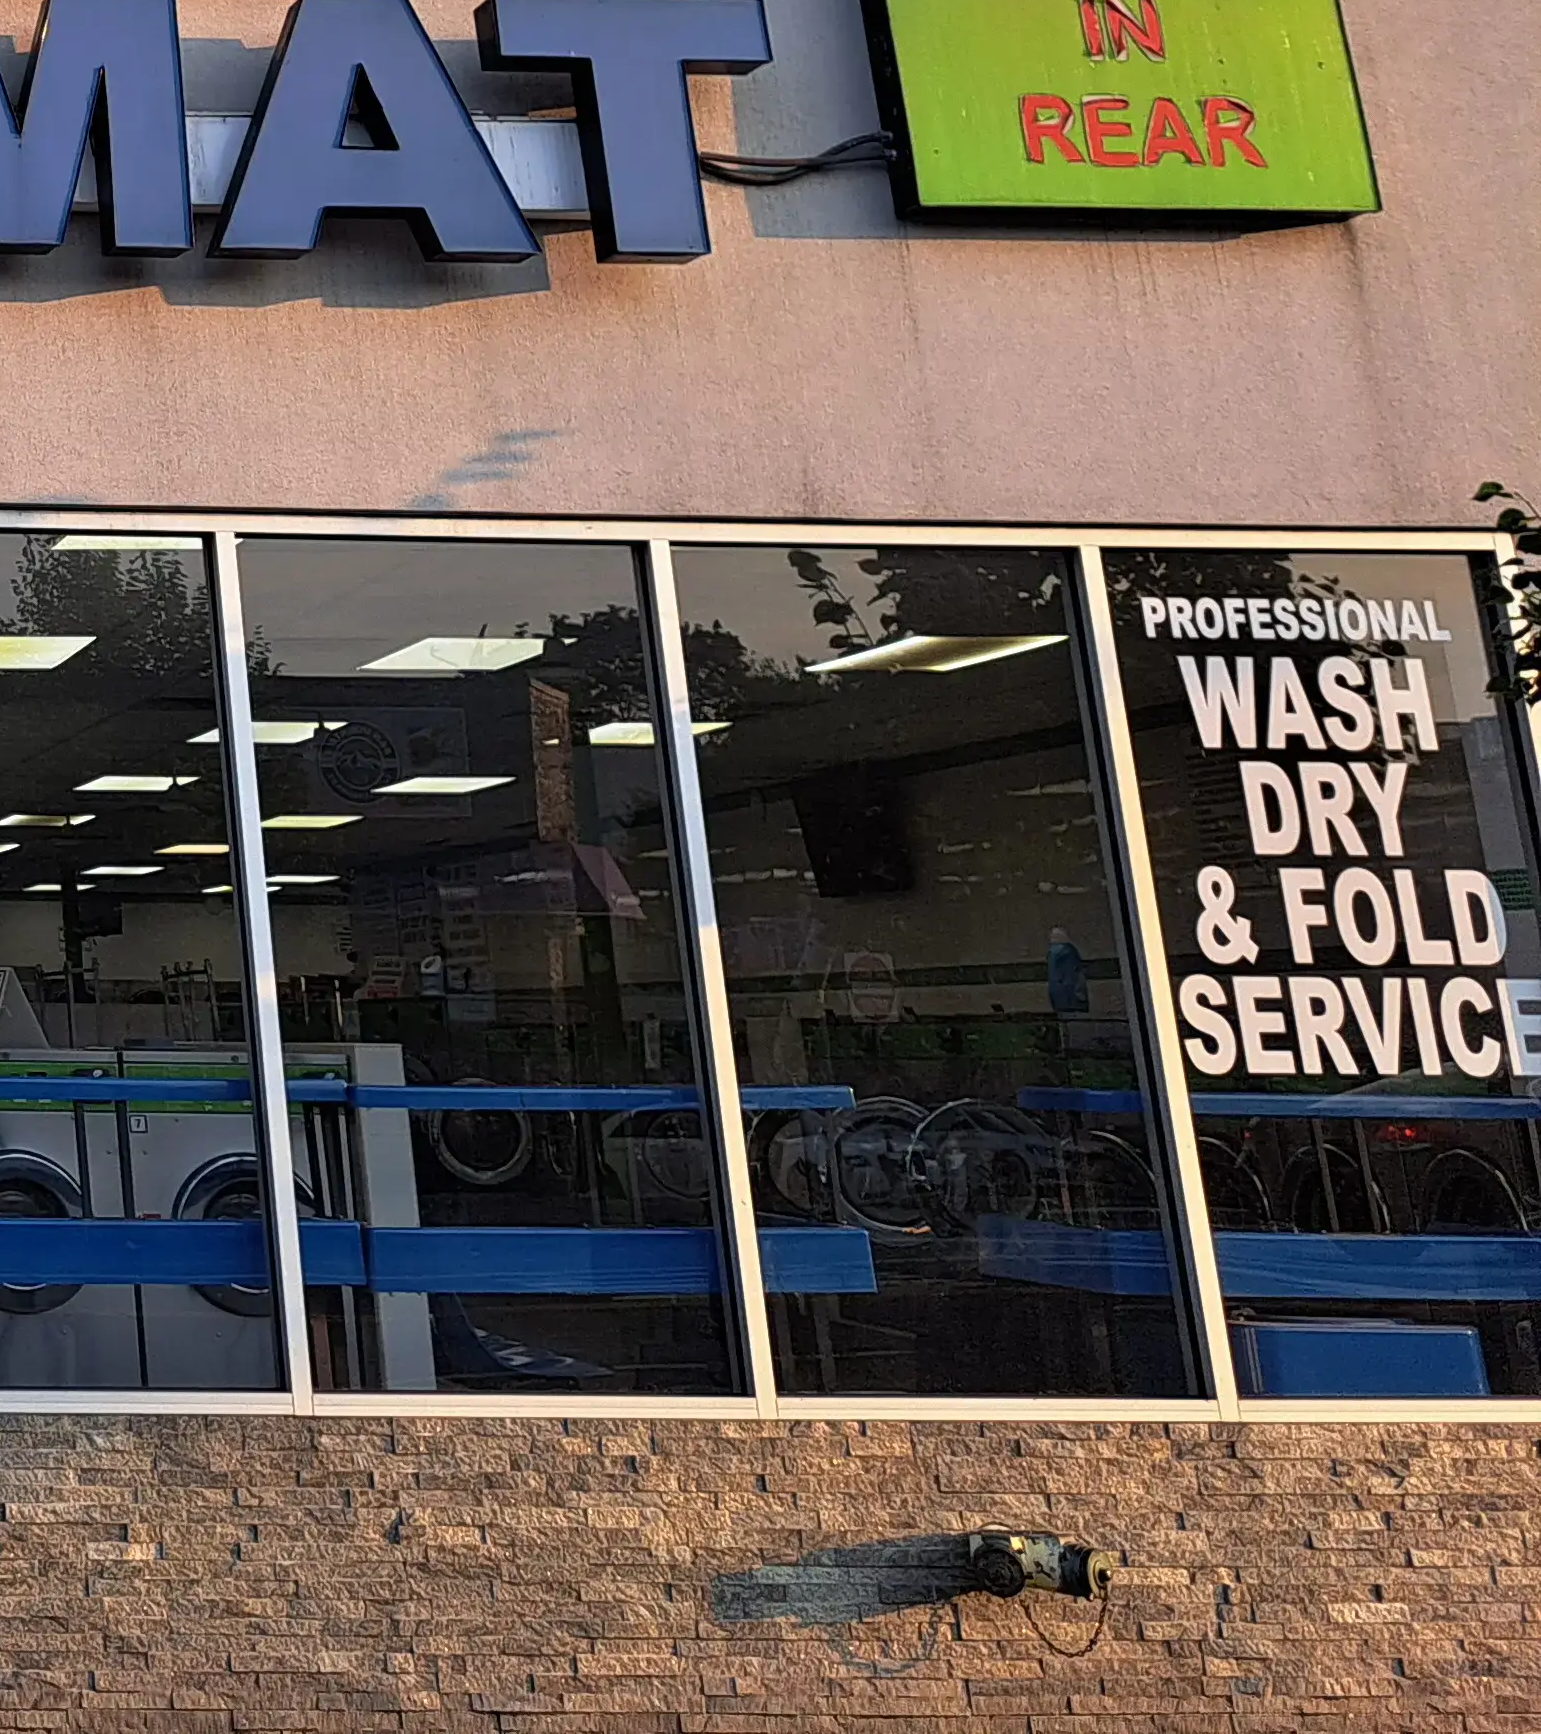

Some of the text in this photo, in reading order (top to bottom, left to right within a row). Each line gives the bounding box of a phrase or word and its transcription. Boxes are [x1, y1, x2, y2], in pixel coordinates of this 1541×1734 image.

[1019, 92, 1268, 168] REAR
[1139, 596, 1452, 642] PROFESSIONAL
[1176, 654, 1440, 752] WASH
[1238, 760, 1409, 857] DRY
[1196, 865, 1508, 967] & FOLD
[1177, 972, 1541, 1078] SERVICE
